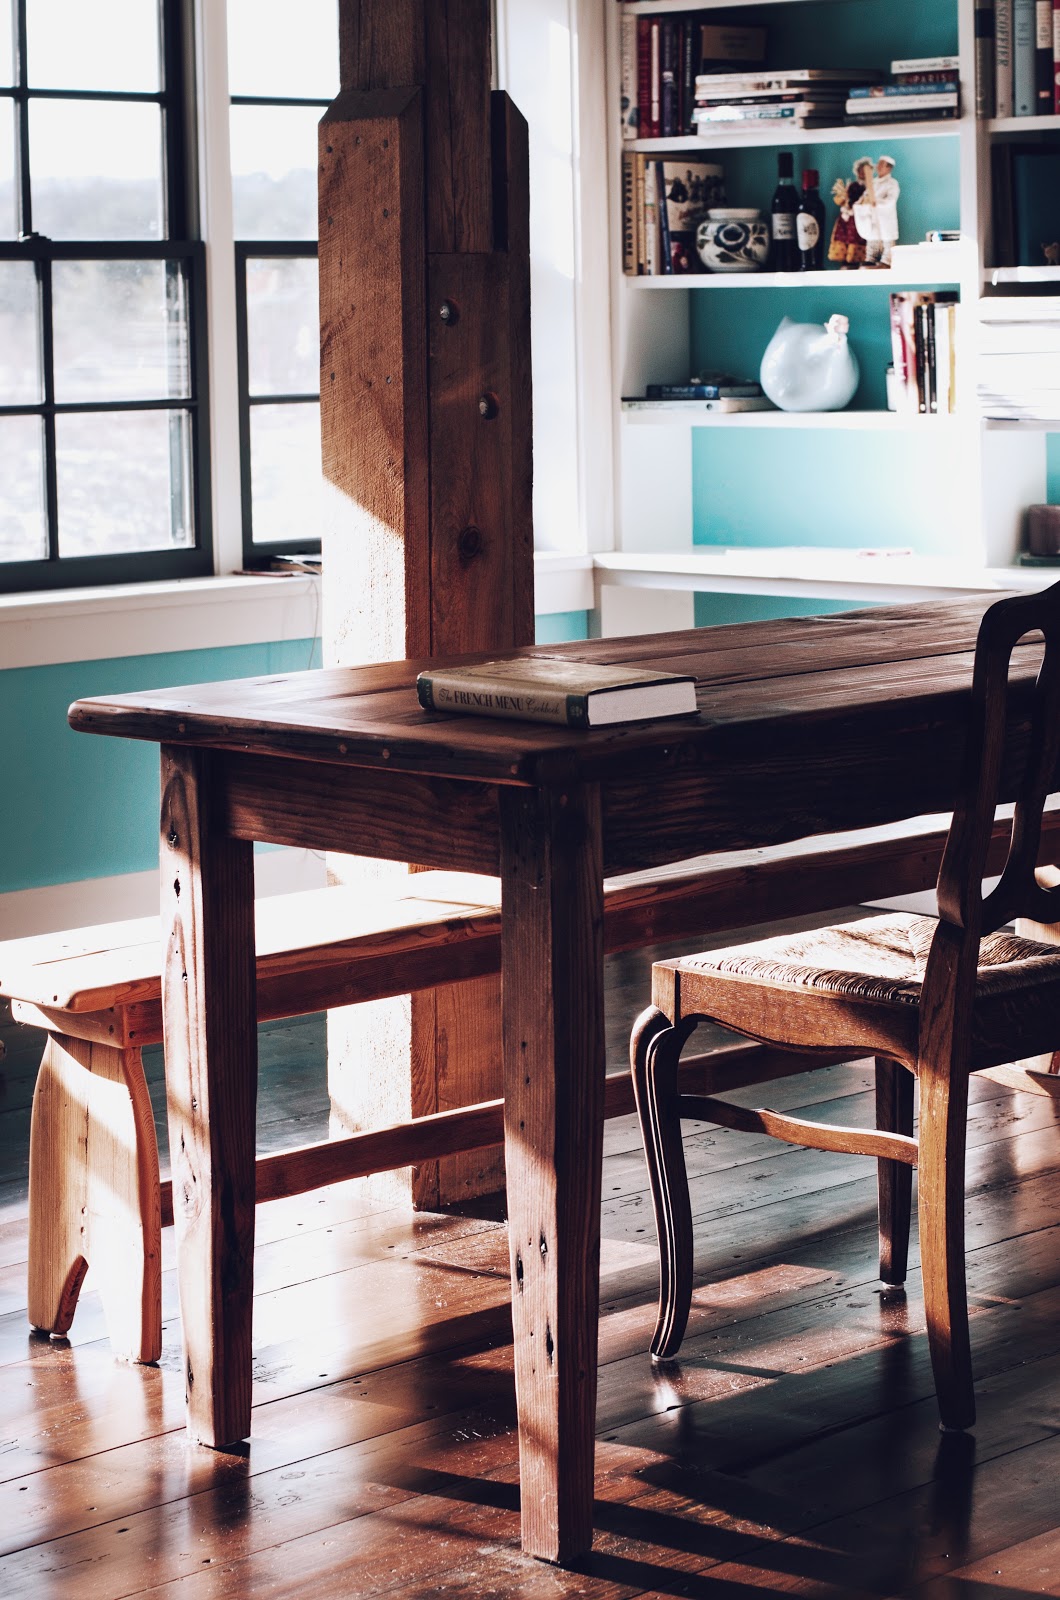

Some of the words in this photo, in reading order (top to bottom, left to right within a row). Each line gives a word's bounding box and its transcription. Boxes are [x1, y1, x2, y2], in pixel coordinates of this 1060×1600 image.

[624, 171, 634, 213] BREAD
[624, 216, 634, 257] ALONE
[438, 688, 453, 703] The
[454, 690, 493, 708] FRENCH
[495, 695, 524, 712] MENU
[526, 696, 561, 715] Cookbook
